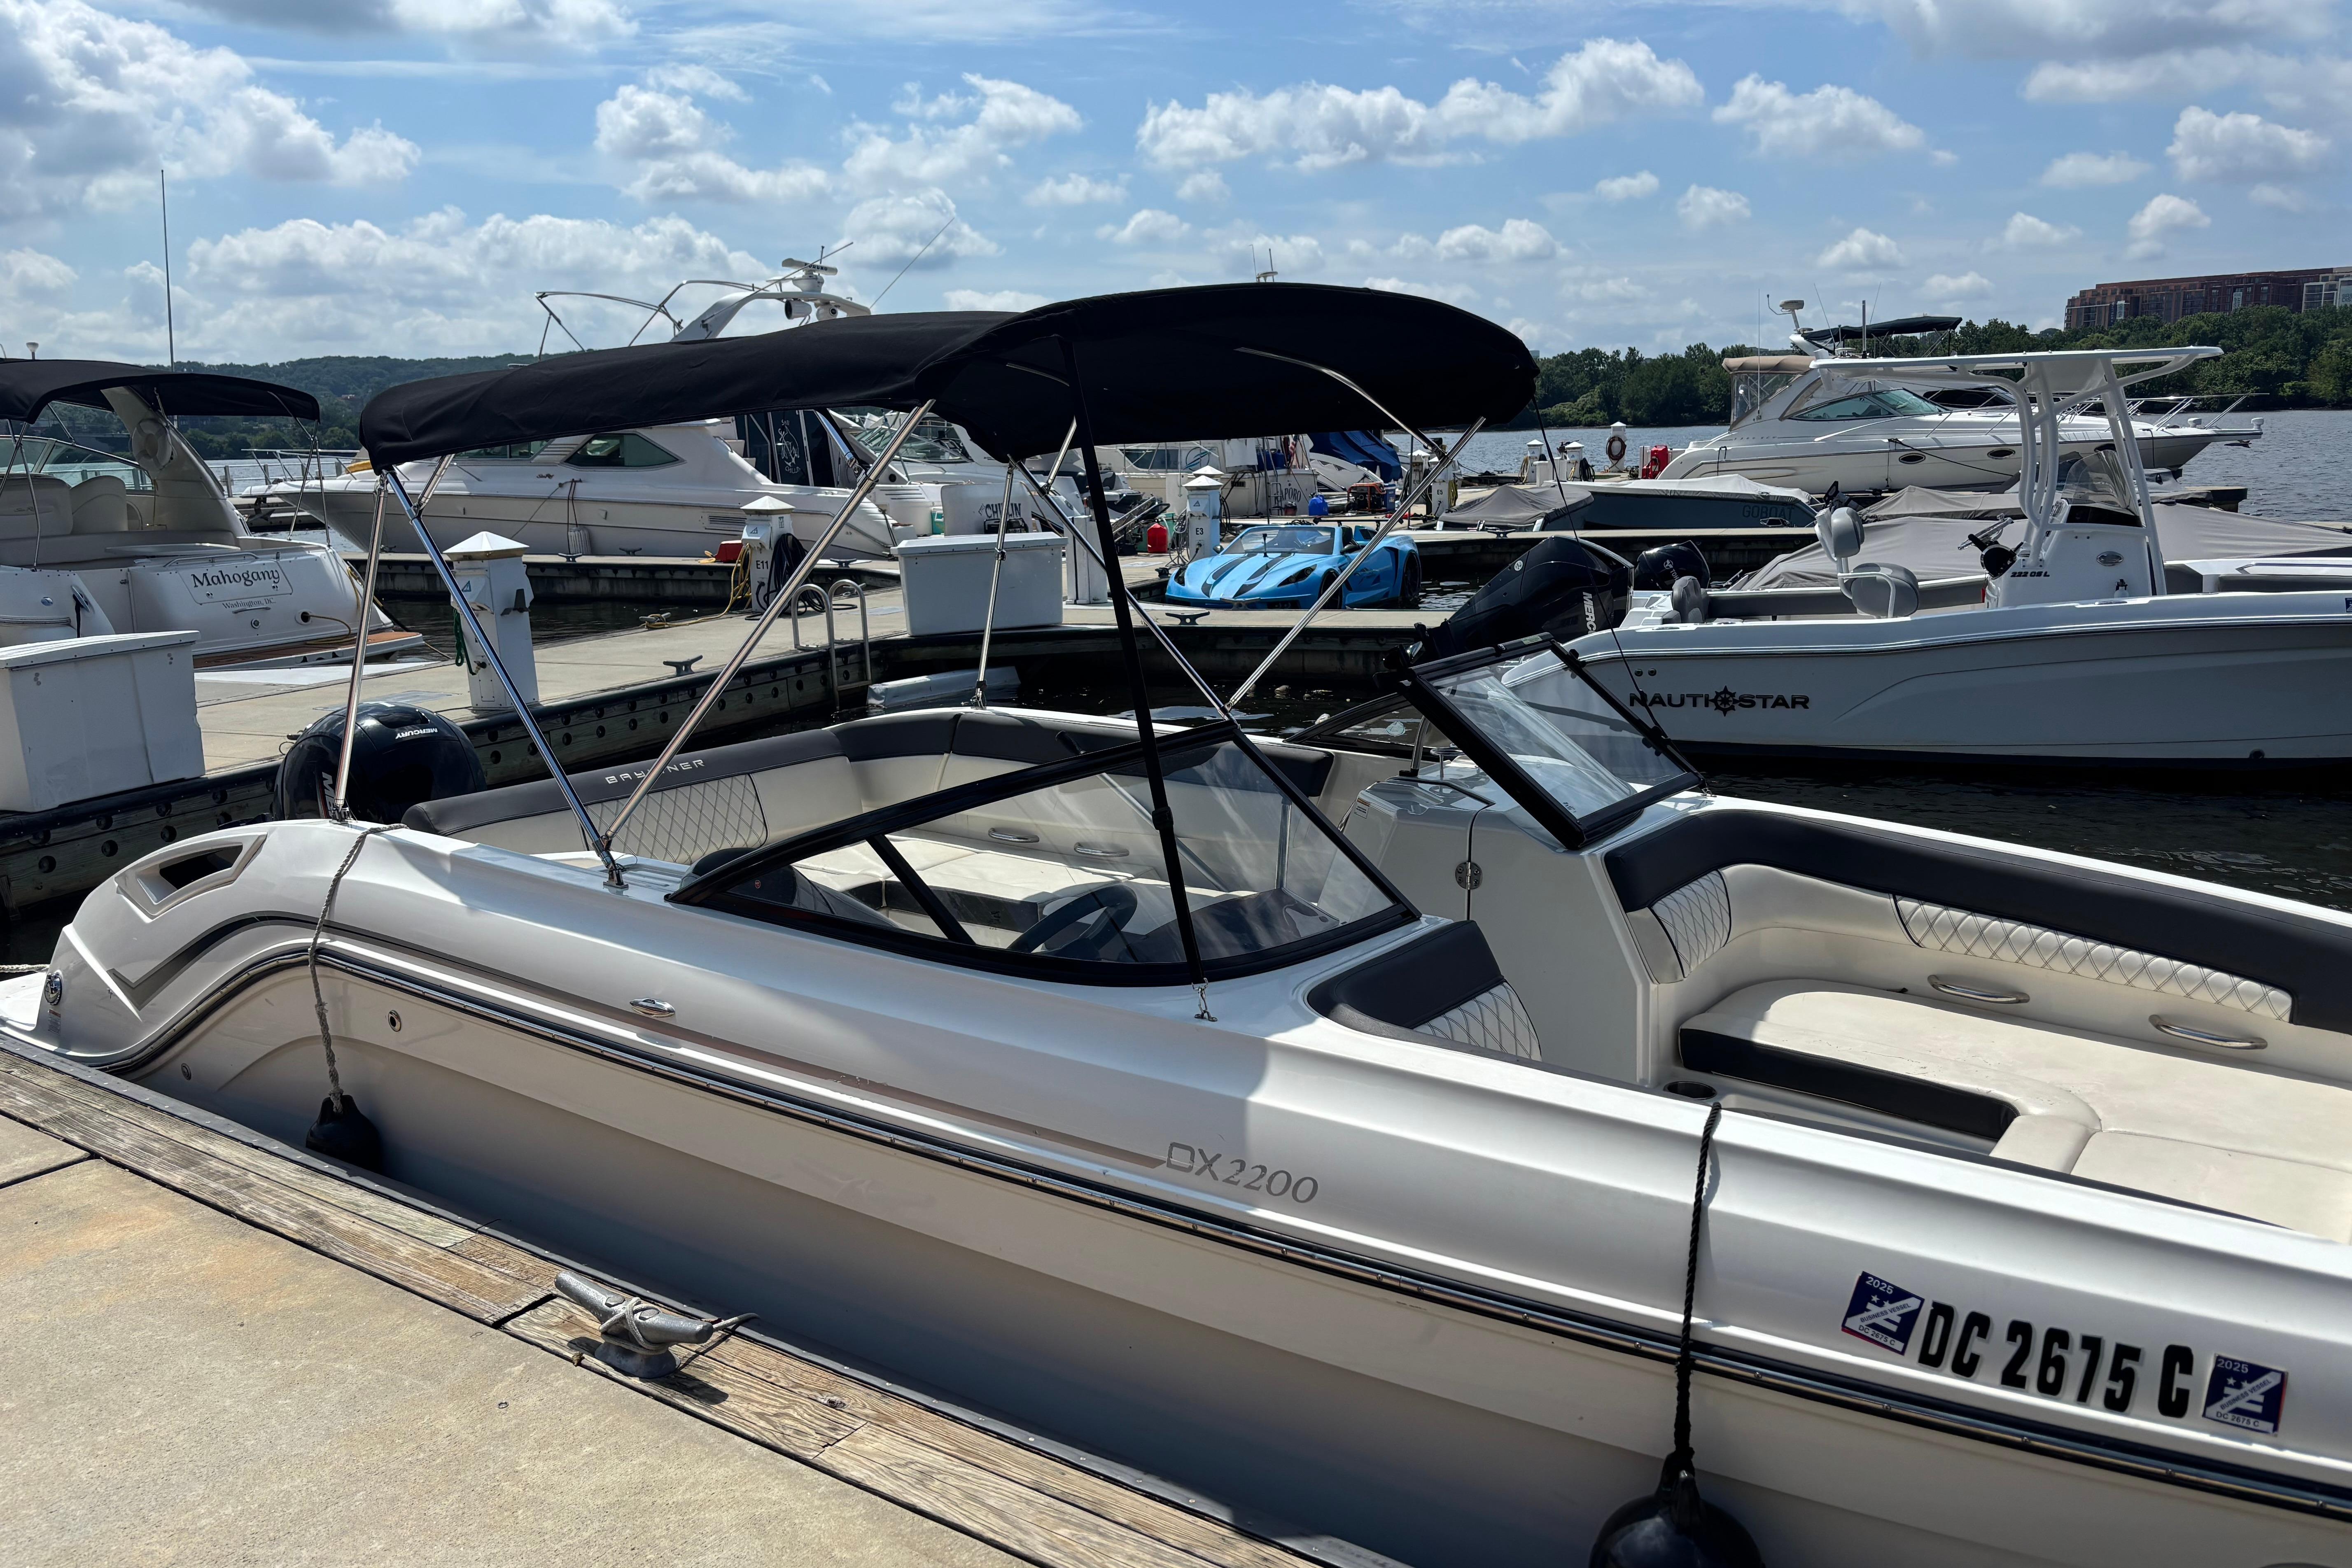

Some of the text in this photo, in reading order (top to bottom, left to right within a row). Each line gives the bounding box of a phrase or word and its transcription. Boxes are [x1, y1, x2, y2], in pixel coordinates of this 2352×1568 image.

[985, 503, 1021, 518] CHILIN
[1742, 505, 1794, 520] GOBOAT
[756, 560, 768, 569] E11
[191, 569, 280, 588] Mahogany
[395, 728, 438, 739] MERCURY
[605, 759, 705, 784] BAYNER
[1866, 1276, 1894, 1294] 2025
[1860, 1303, 1911, 1323] BUSINESS VESSEL
[1859, 1325, 1870, 1334] DC
[1871, 1330, 1888, 1343] 2675
[1918, 1300, 2195, 1419] DC 2675 C
[2217, 1359, 2249, 1374] 2025
[2220, 1379, 2272, 1410] BUSINESS VESSEL
[2216, 1411, 2229, 1419] DC
[2230, 1414, 2251, 1426] 2675
